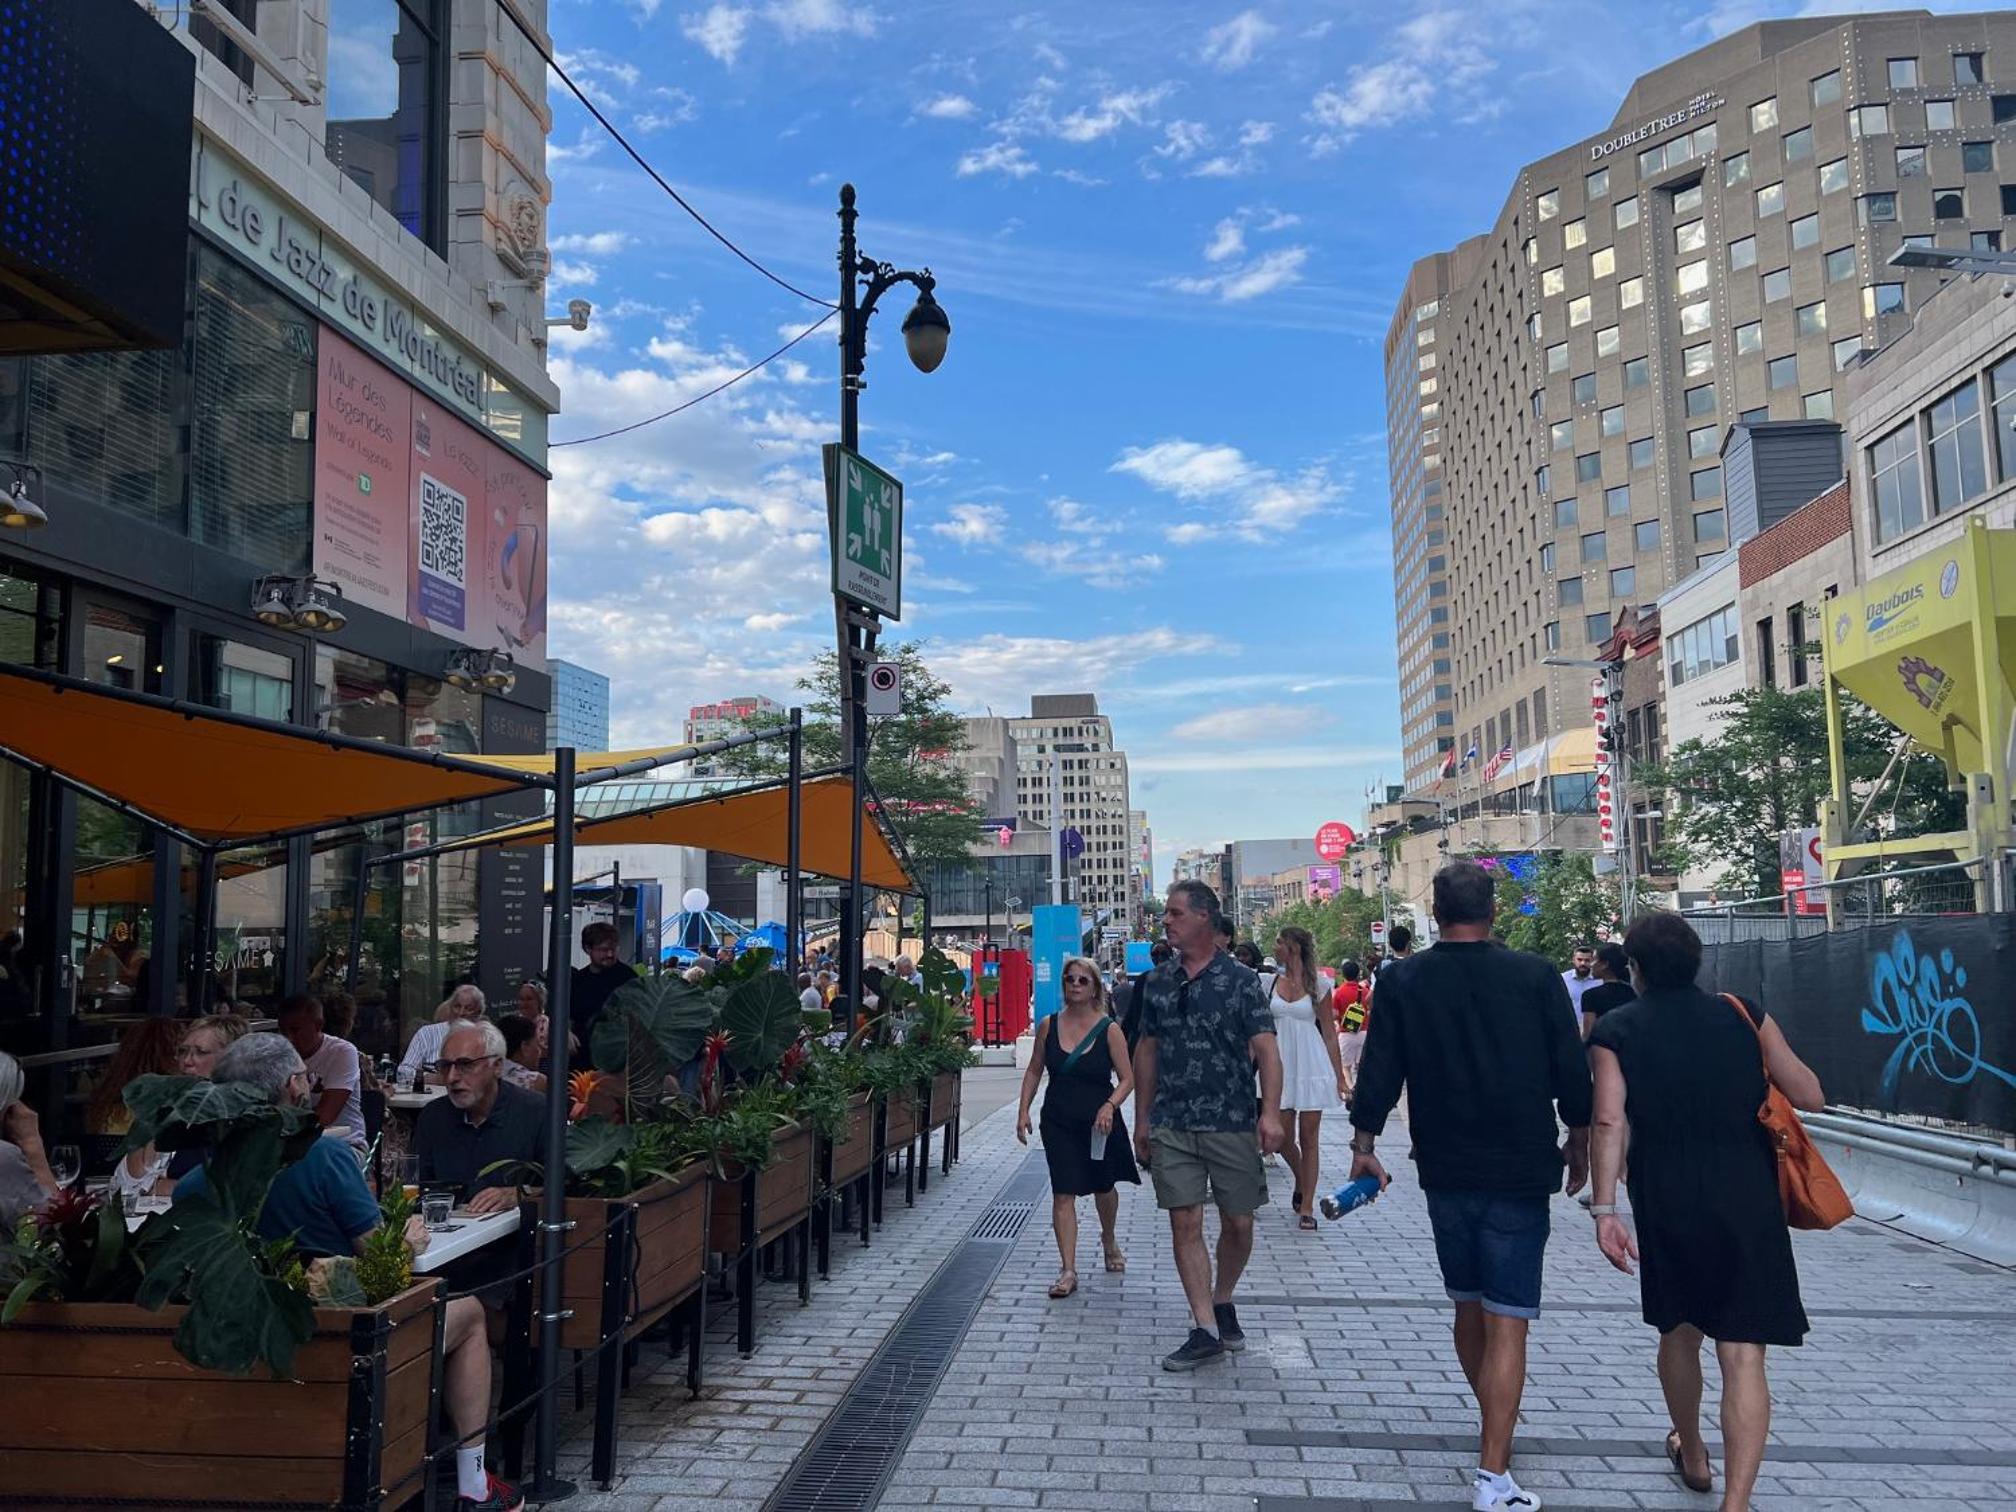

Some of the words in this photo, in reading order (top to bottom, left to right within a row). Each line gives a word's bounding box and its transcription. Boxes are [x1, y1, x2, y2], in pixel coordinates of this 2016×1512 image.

[218, 179, 264, 247] de
[270, 216, 336, 301] Jazz
[342, 274, 378, 332] de
[383, 298, 485, 411] Montréal
[328, 356, 356, 390] Mur
[361, 381, 386, 413] des
[328, 383, 393, 444] Légendes
[1866, 583, 1925, 621] Daubois
